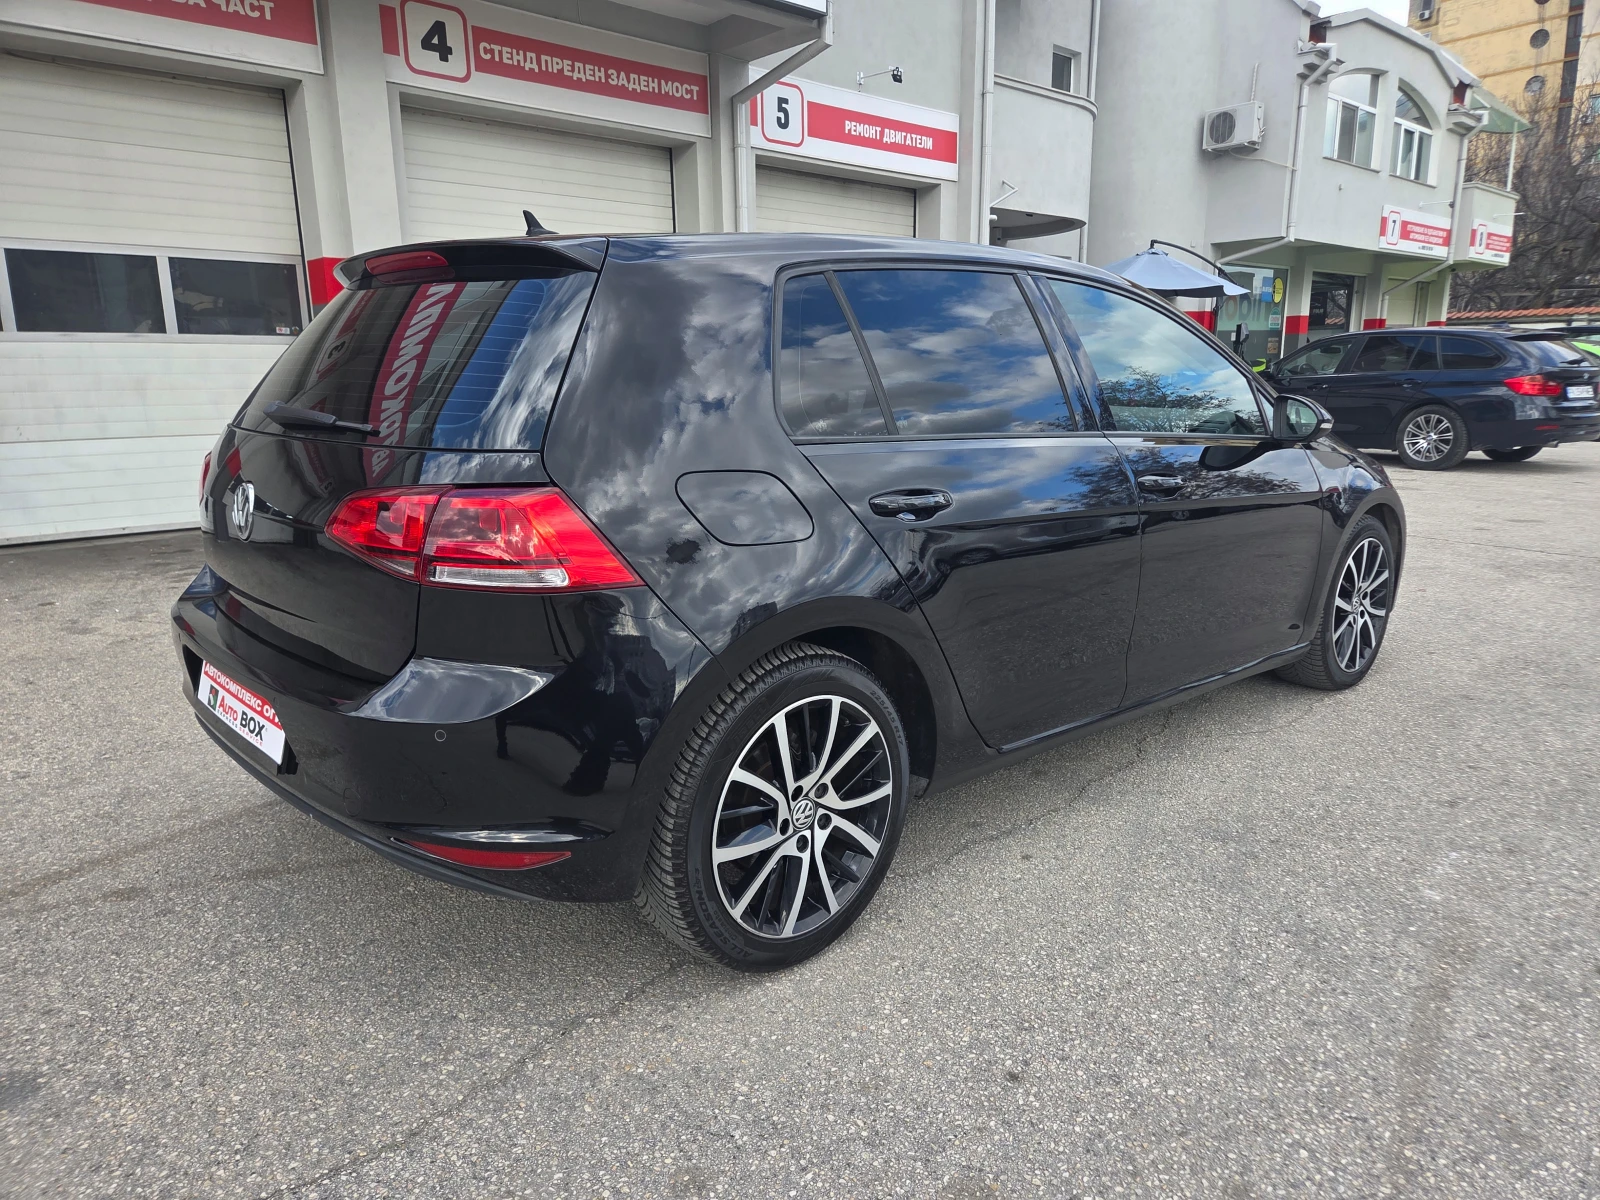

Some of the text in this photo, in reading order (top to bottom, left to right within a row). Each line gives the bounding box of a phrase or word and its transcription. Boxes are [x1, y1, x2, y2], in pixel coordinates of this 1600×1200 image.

[420, 20, 453, 63] 4
[479, 41, 699, 101] СТЕНД ПРЕДЕН ЗАДЕН МОСТ
[776, 96, 790, 130] 5
[844, 120, 933, 150] РЕМОНТ ДВИГАТЕЛИ
[1391, 219, 1397, 237] 7
[204, 662, 281, 726] АВТОКОМПЛЕКС ОГ
[217, 708, 263, 748] EXPRESS SERVICE
[240, 709, 265, 742] BOX
